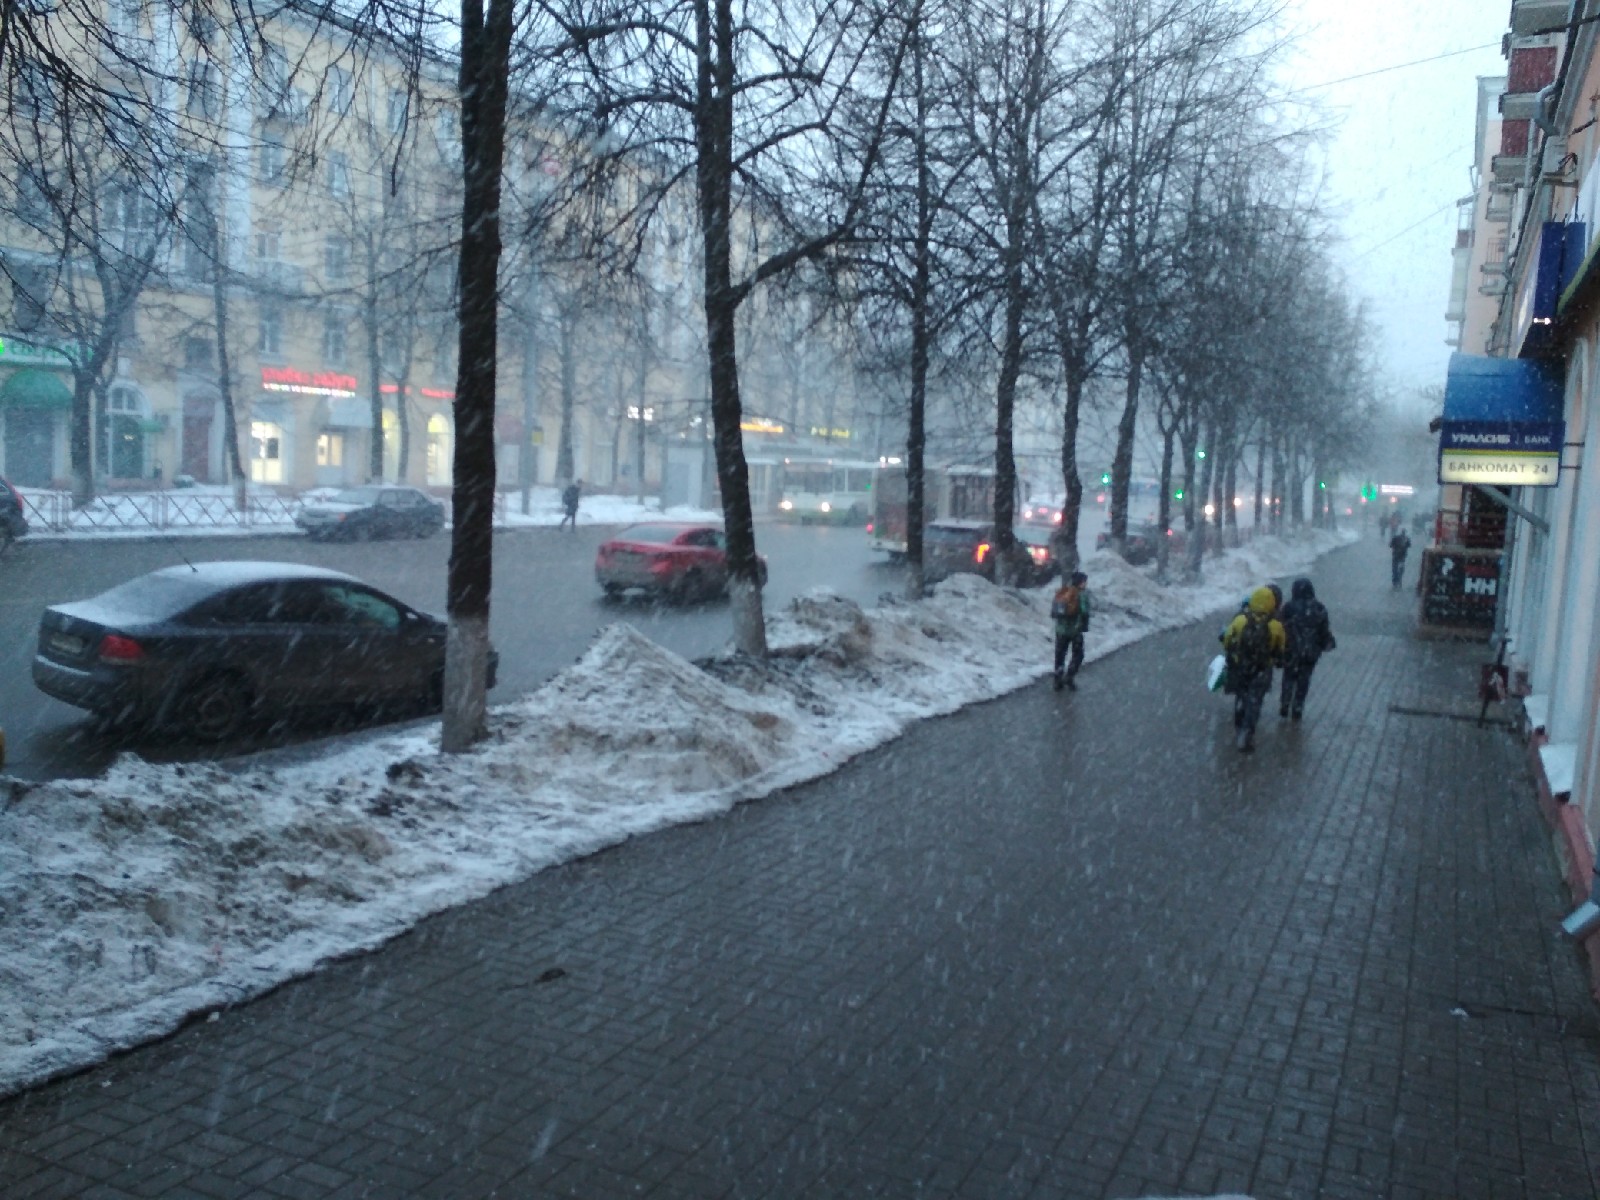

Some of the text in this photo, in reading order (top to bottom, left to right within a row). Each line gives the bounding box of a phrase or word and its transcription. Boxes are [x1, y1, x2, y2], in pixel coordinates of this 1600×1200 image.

[1451, 433, 1552, 444] УРАЛСИБ БАНК
[1448, 462, 1549, 475] БАНКОМАТ 24
